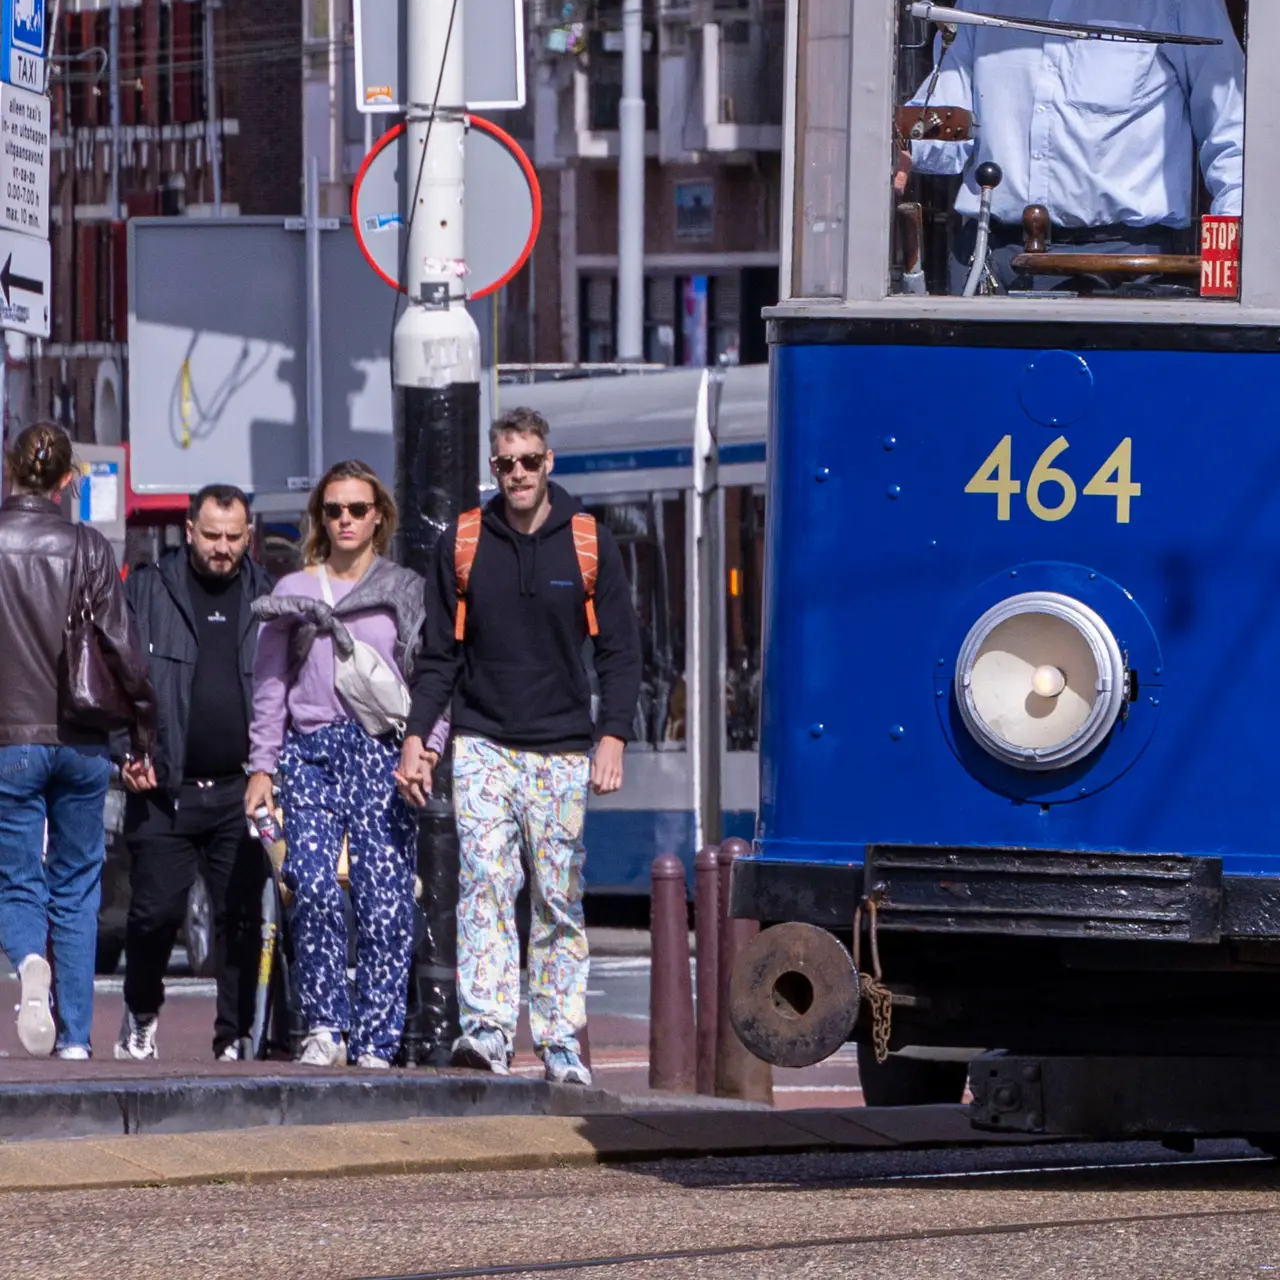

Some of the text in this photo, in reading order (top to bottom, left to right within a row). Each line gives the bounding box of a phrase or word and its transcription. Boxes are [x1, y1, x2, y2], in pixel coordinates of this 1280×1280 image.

[18, 55, 37, 85] TAXI
[9, 97, 25, 117] alleen
[20, 124, 47, 146] uitstappen
[1201, 260, 1238, 288] NIE
[964, 434, 1141, 524] 464
